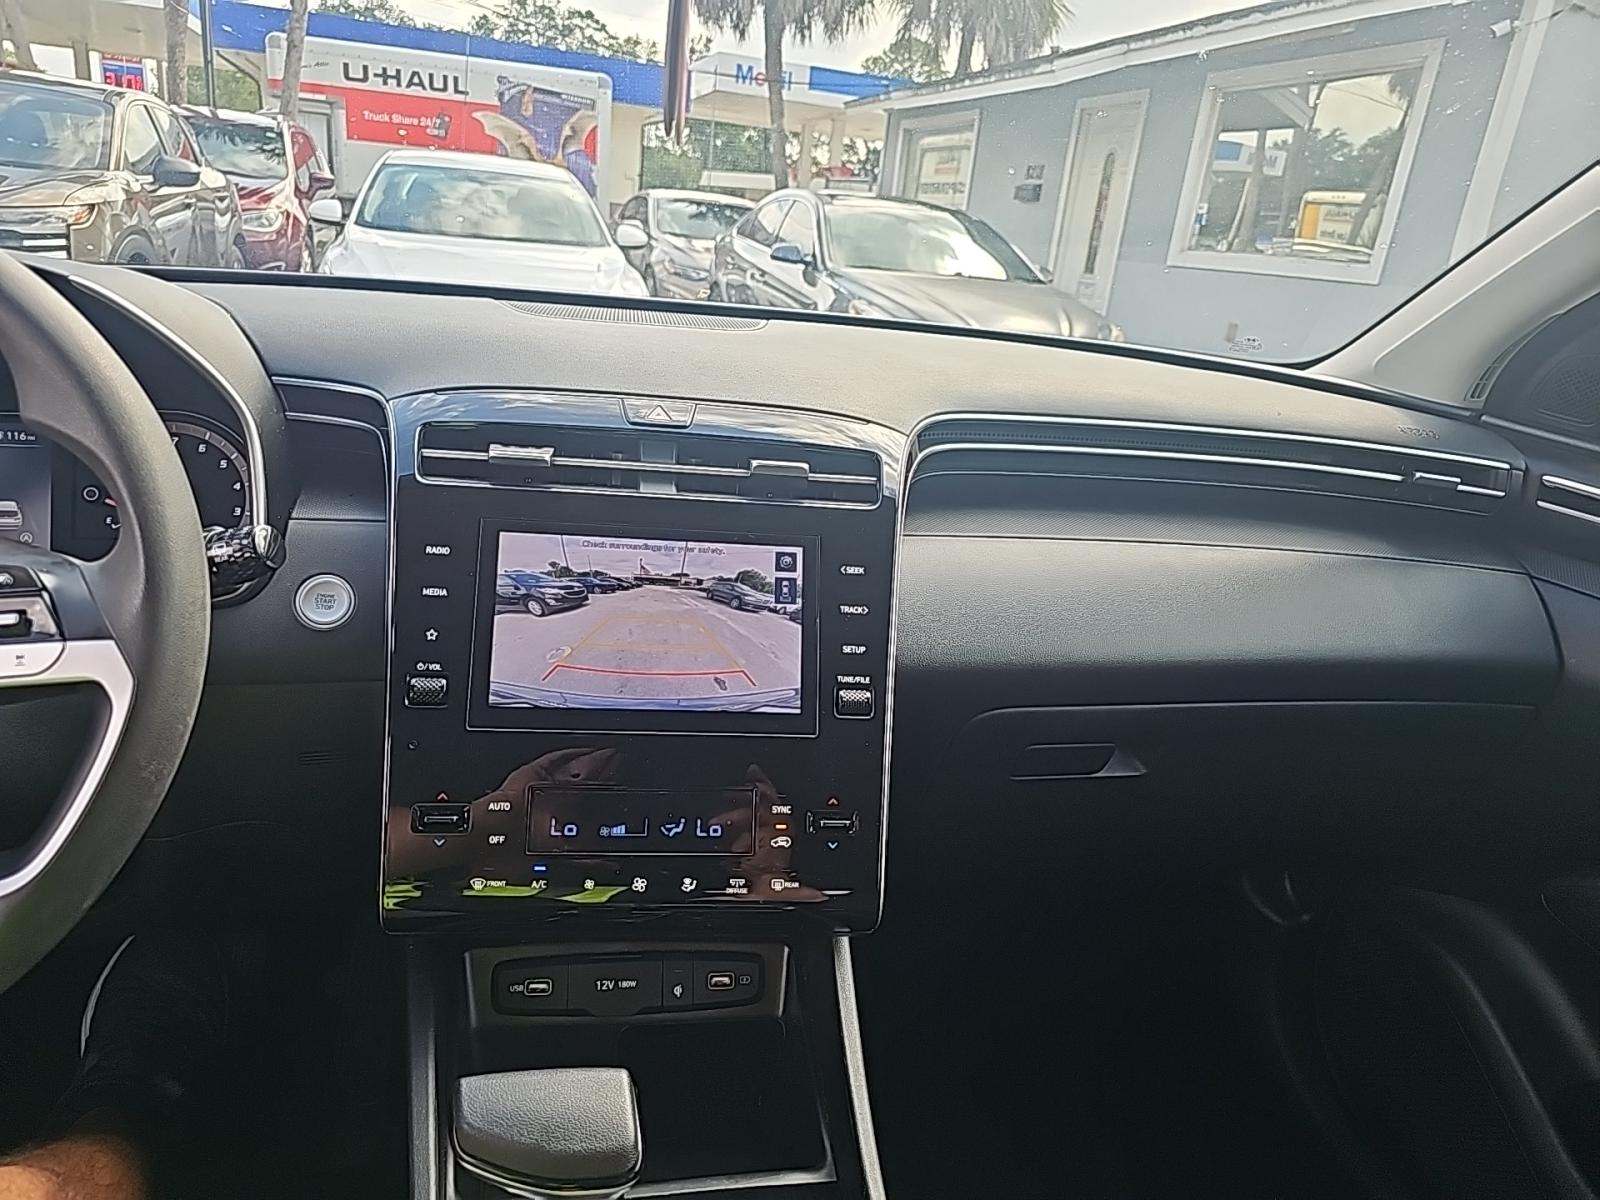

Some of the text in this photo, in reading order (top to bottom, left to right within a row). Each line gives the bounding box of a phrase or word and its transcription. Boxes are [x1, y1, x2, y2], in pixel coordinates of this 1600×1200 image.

[342, 61, 469, 96] U-HAUL
[736, 63, 793, 91] Moil
[362, 110, 390, 123] Truck
[391, 112, 419, 126] Share
[198, 443, 207, 453] 6
[219, 459, 228, 469] 5
[232, 482, 241, 491] 4
[232, 506, 241, 516] 3
[425, 545, 451, 555] RADIO
[582, 539, 607, 549] Check
[609, 542, 662, 553] surroundings
[663, 543, 676, 552] for
[698, 546, 726, 556] safety.
[422, 587, 448, 596] MEDIA
[314, 597, 337, 605] START
[315, 603, 335, 611] STOP
[842, 645, 867, 654] SETUP
[836, 675, 871, 684] TUNE/FILE
[488, 801, 511, 811] AUTO
[771, 805, 792, 814] SYNC
[488, 835, 506, 844] OFF
[531, 879, 548, 888] A/C
[509, 985, 524, 993] USB
[596, 979, 615, 991] 12V
